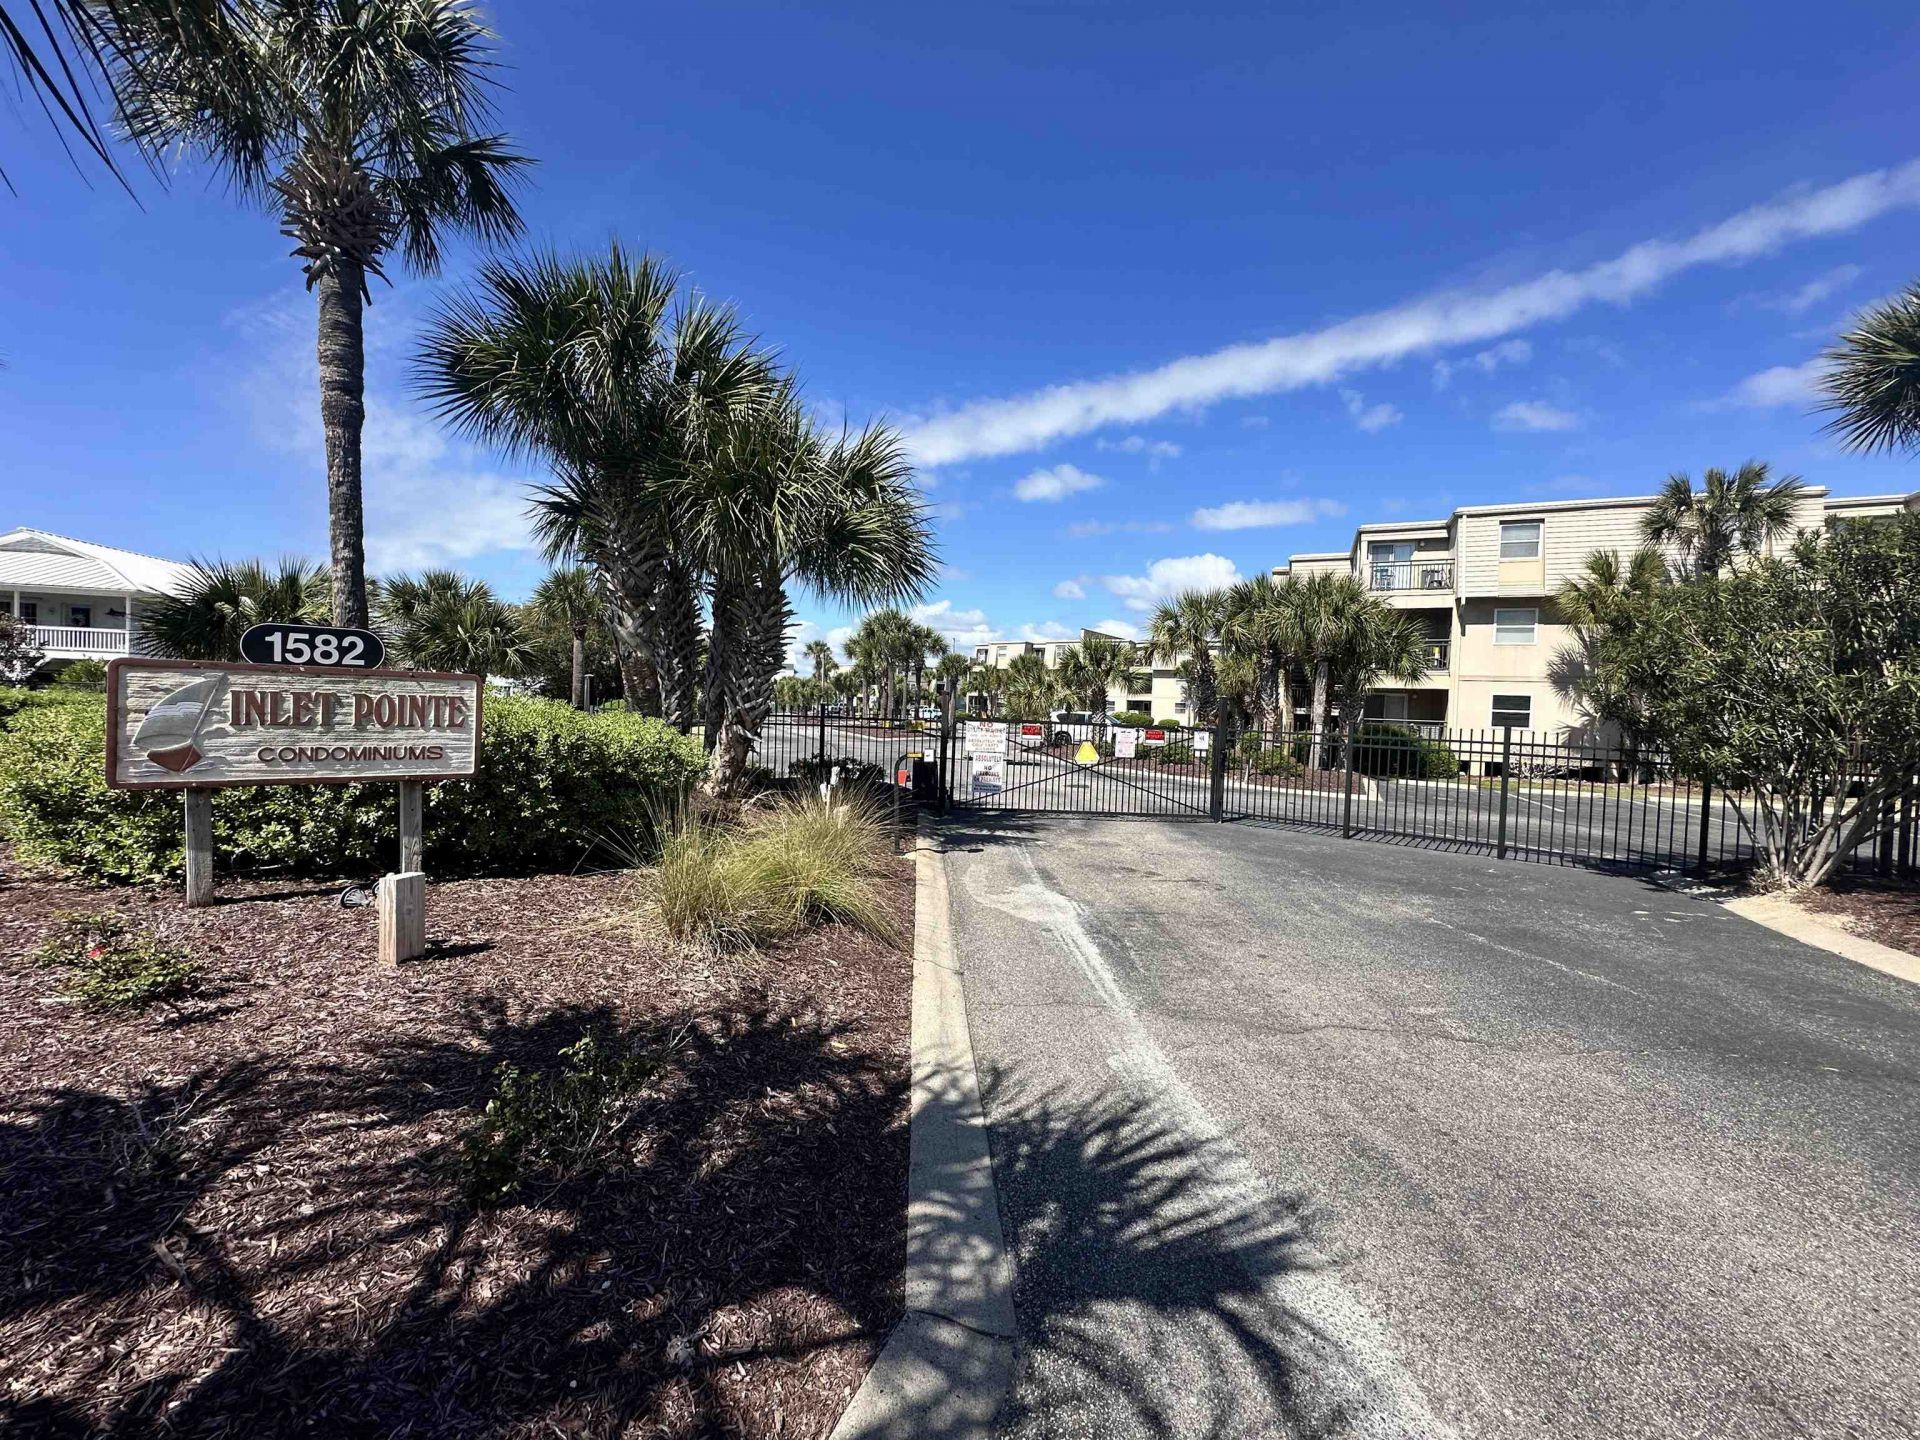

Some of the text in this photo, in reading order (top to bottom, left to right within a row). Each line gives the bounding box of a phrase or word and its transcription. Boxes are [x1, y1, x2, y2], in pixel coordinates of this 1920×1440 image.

[264, 631, 365, 665] 1582
[229, 690, 466, 728] INLET POINTE
[257, 745, 444, 762] CONDOMINIUMS
